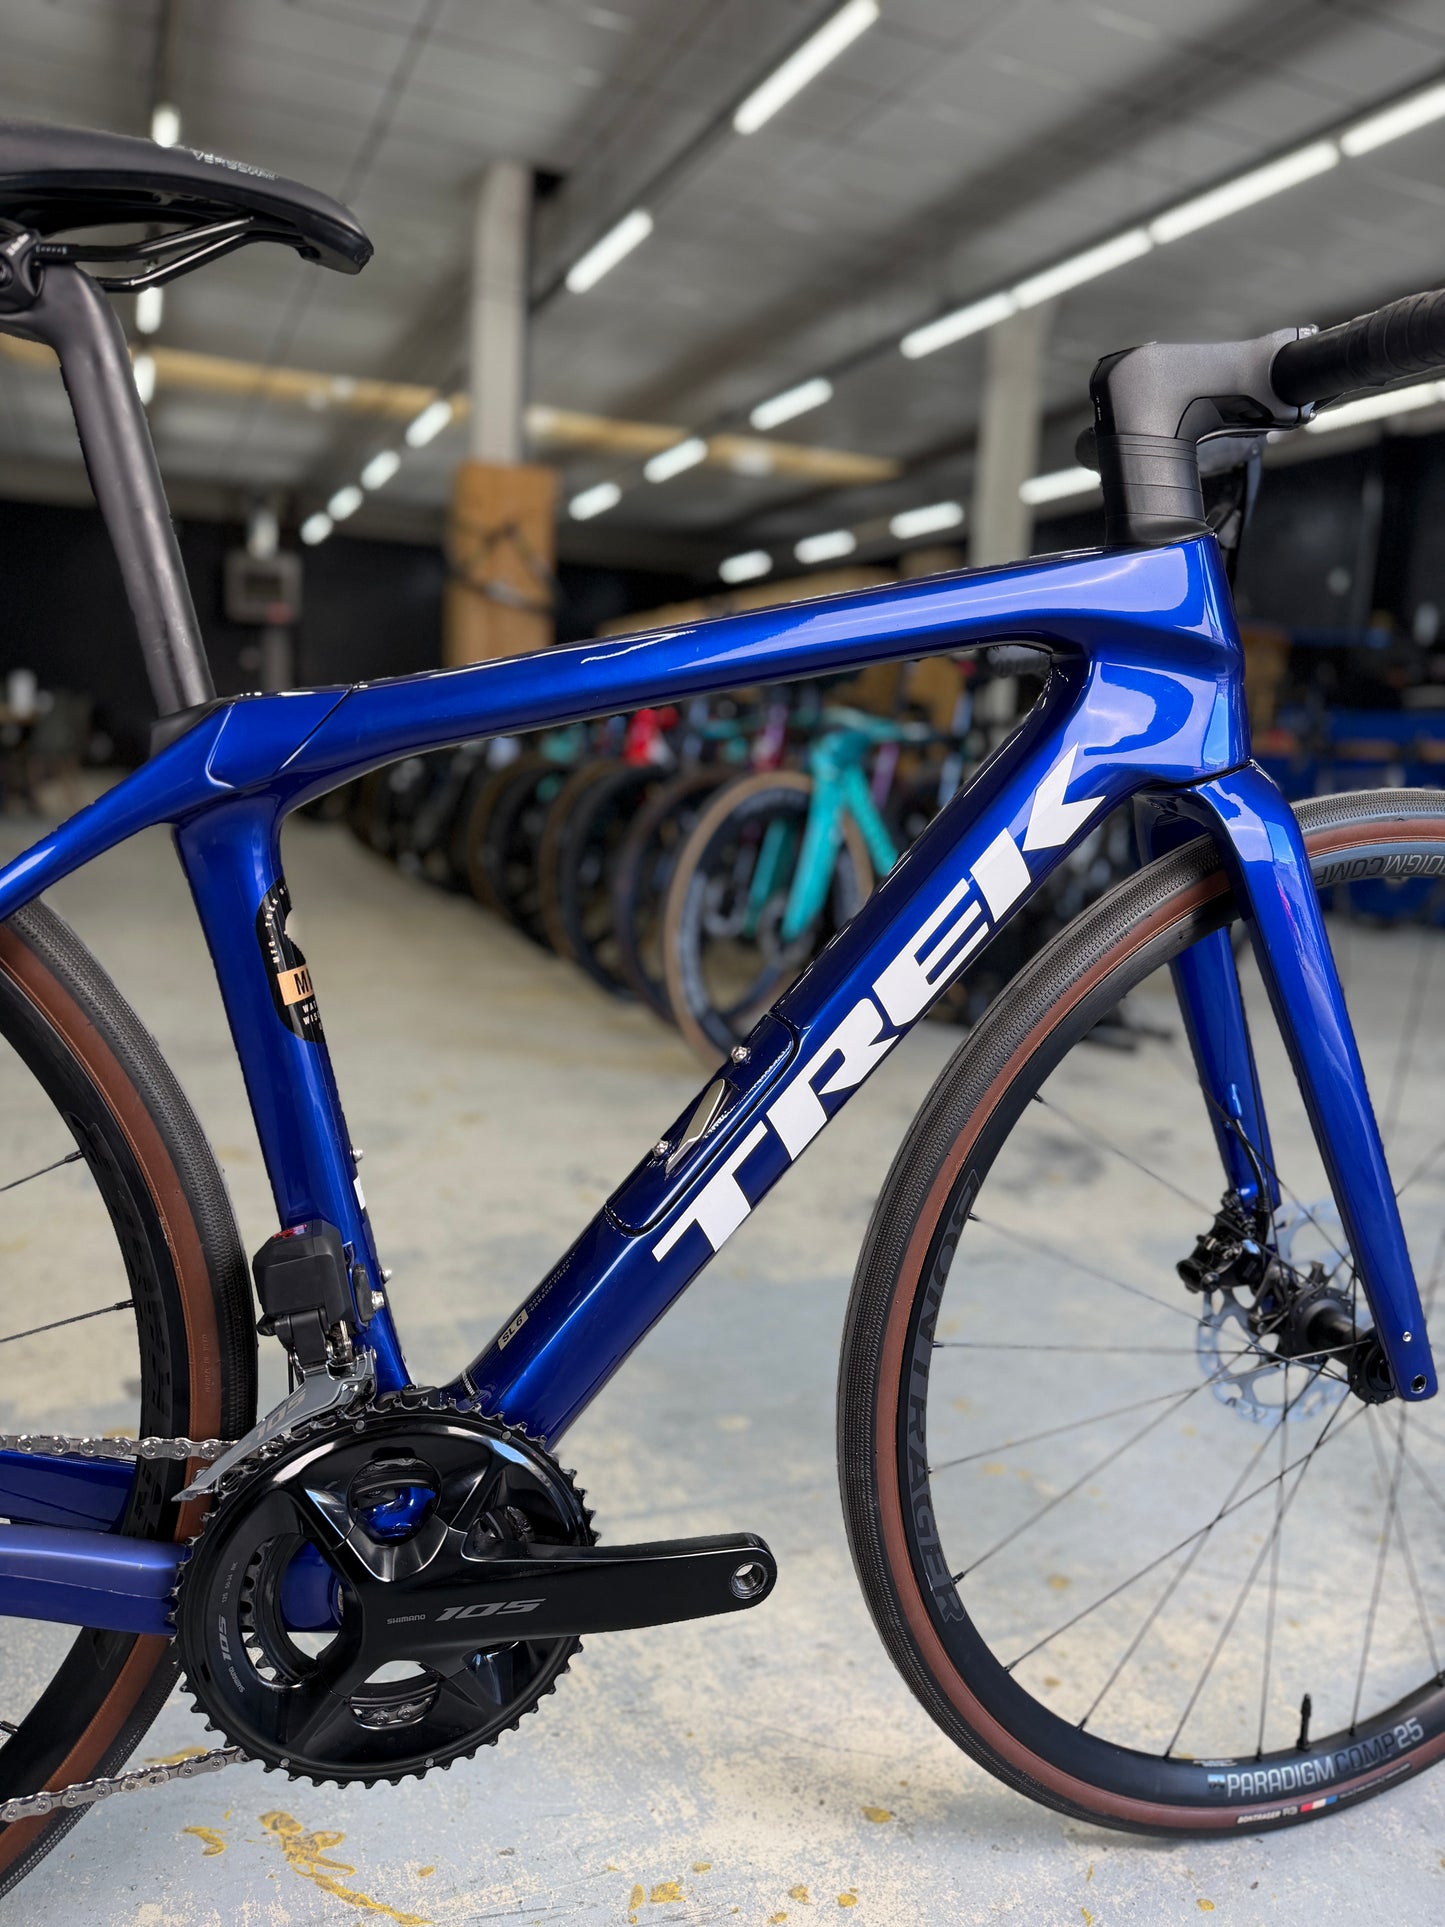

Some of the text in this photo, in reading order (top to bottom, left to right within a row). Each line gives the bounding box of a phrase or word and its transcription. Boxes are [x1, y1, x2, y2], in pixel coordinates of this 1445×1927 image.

[265, 898, 279, 927] TREK
[651, 742, 1106, 1262] TREK
[502, 1316, 523, 1343] SL 6
[257, 1389, 306, 1440] 105
[908, 1169, 980, 1623] BONTRAGER
[386, 1598, 547, 1625] SHIMANO 105
[218, 1614, 232, 1661] 105
[228, 1666, 246, 1693] SHIMANO
[1227, 1756, 1335, 1798] PARADIGM
[1334, 1732, 1396, 1773] COMP
[1396, 1717, 1424, 1749] 25
[1236, 1810, 1282, 1825] BONTRAGER
